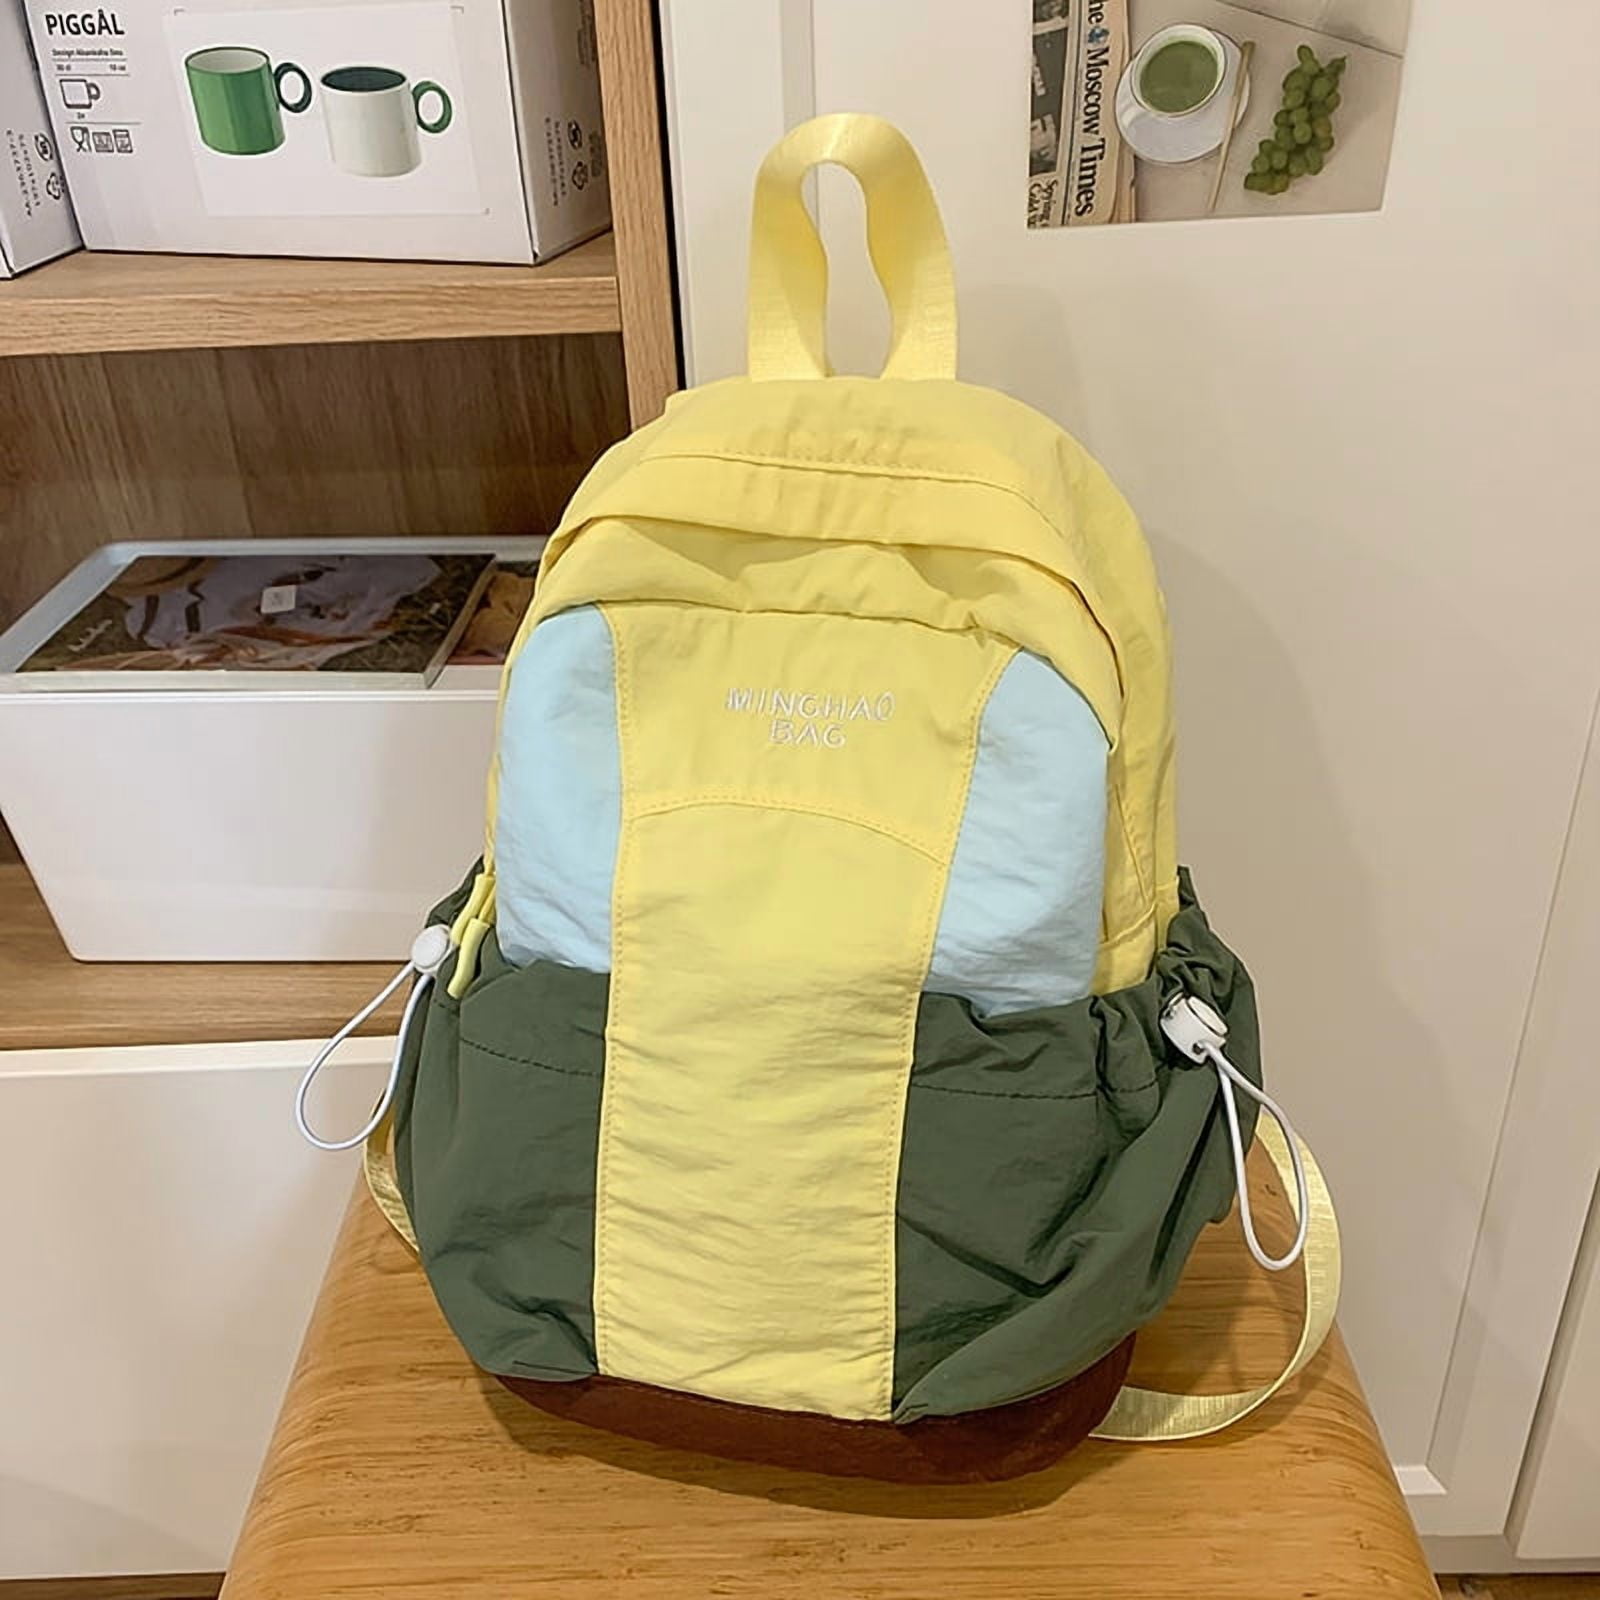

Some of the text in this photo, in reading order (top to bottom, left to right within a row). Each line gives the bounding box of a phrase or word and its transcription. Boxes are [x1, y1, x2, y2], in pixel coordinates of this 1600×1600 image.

[45, 9, 125, 36] PIGGÅL
[1074, 0, 1110, 217] he Moscow Times
[727, 687, 896, 721] MINGHAO
[770, 718, 847, 750] BAG
